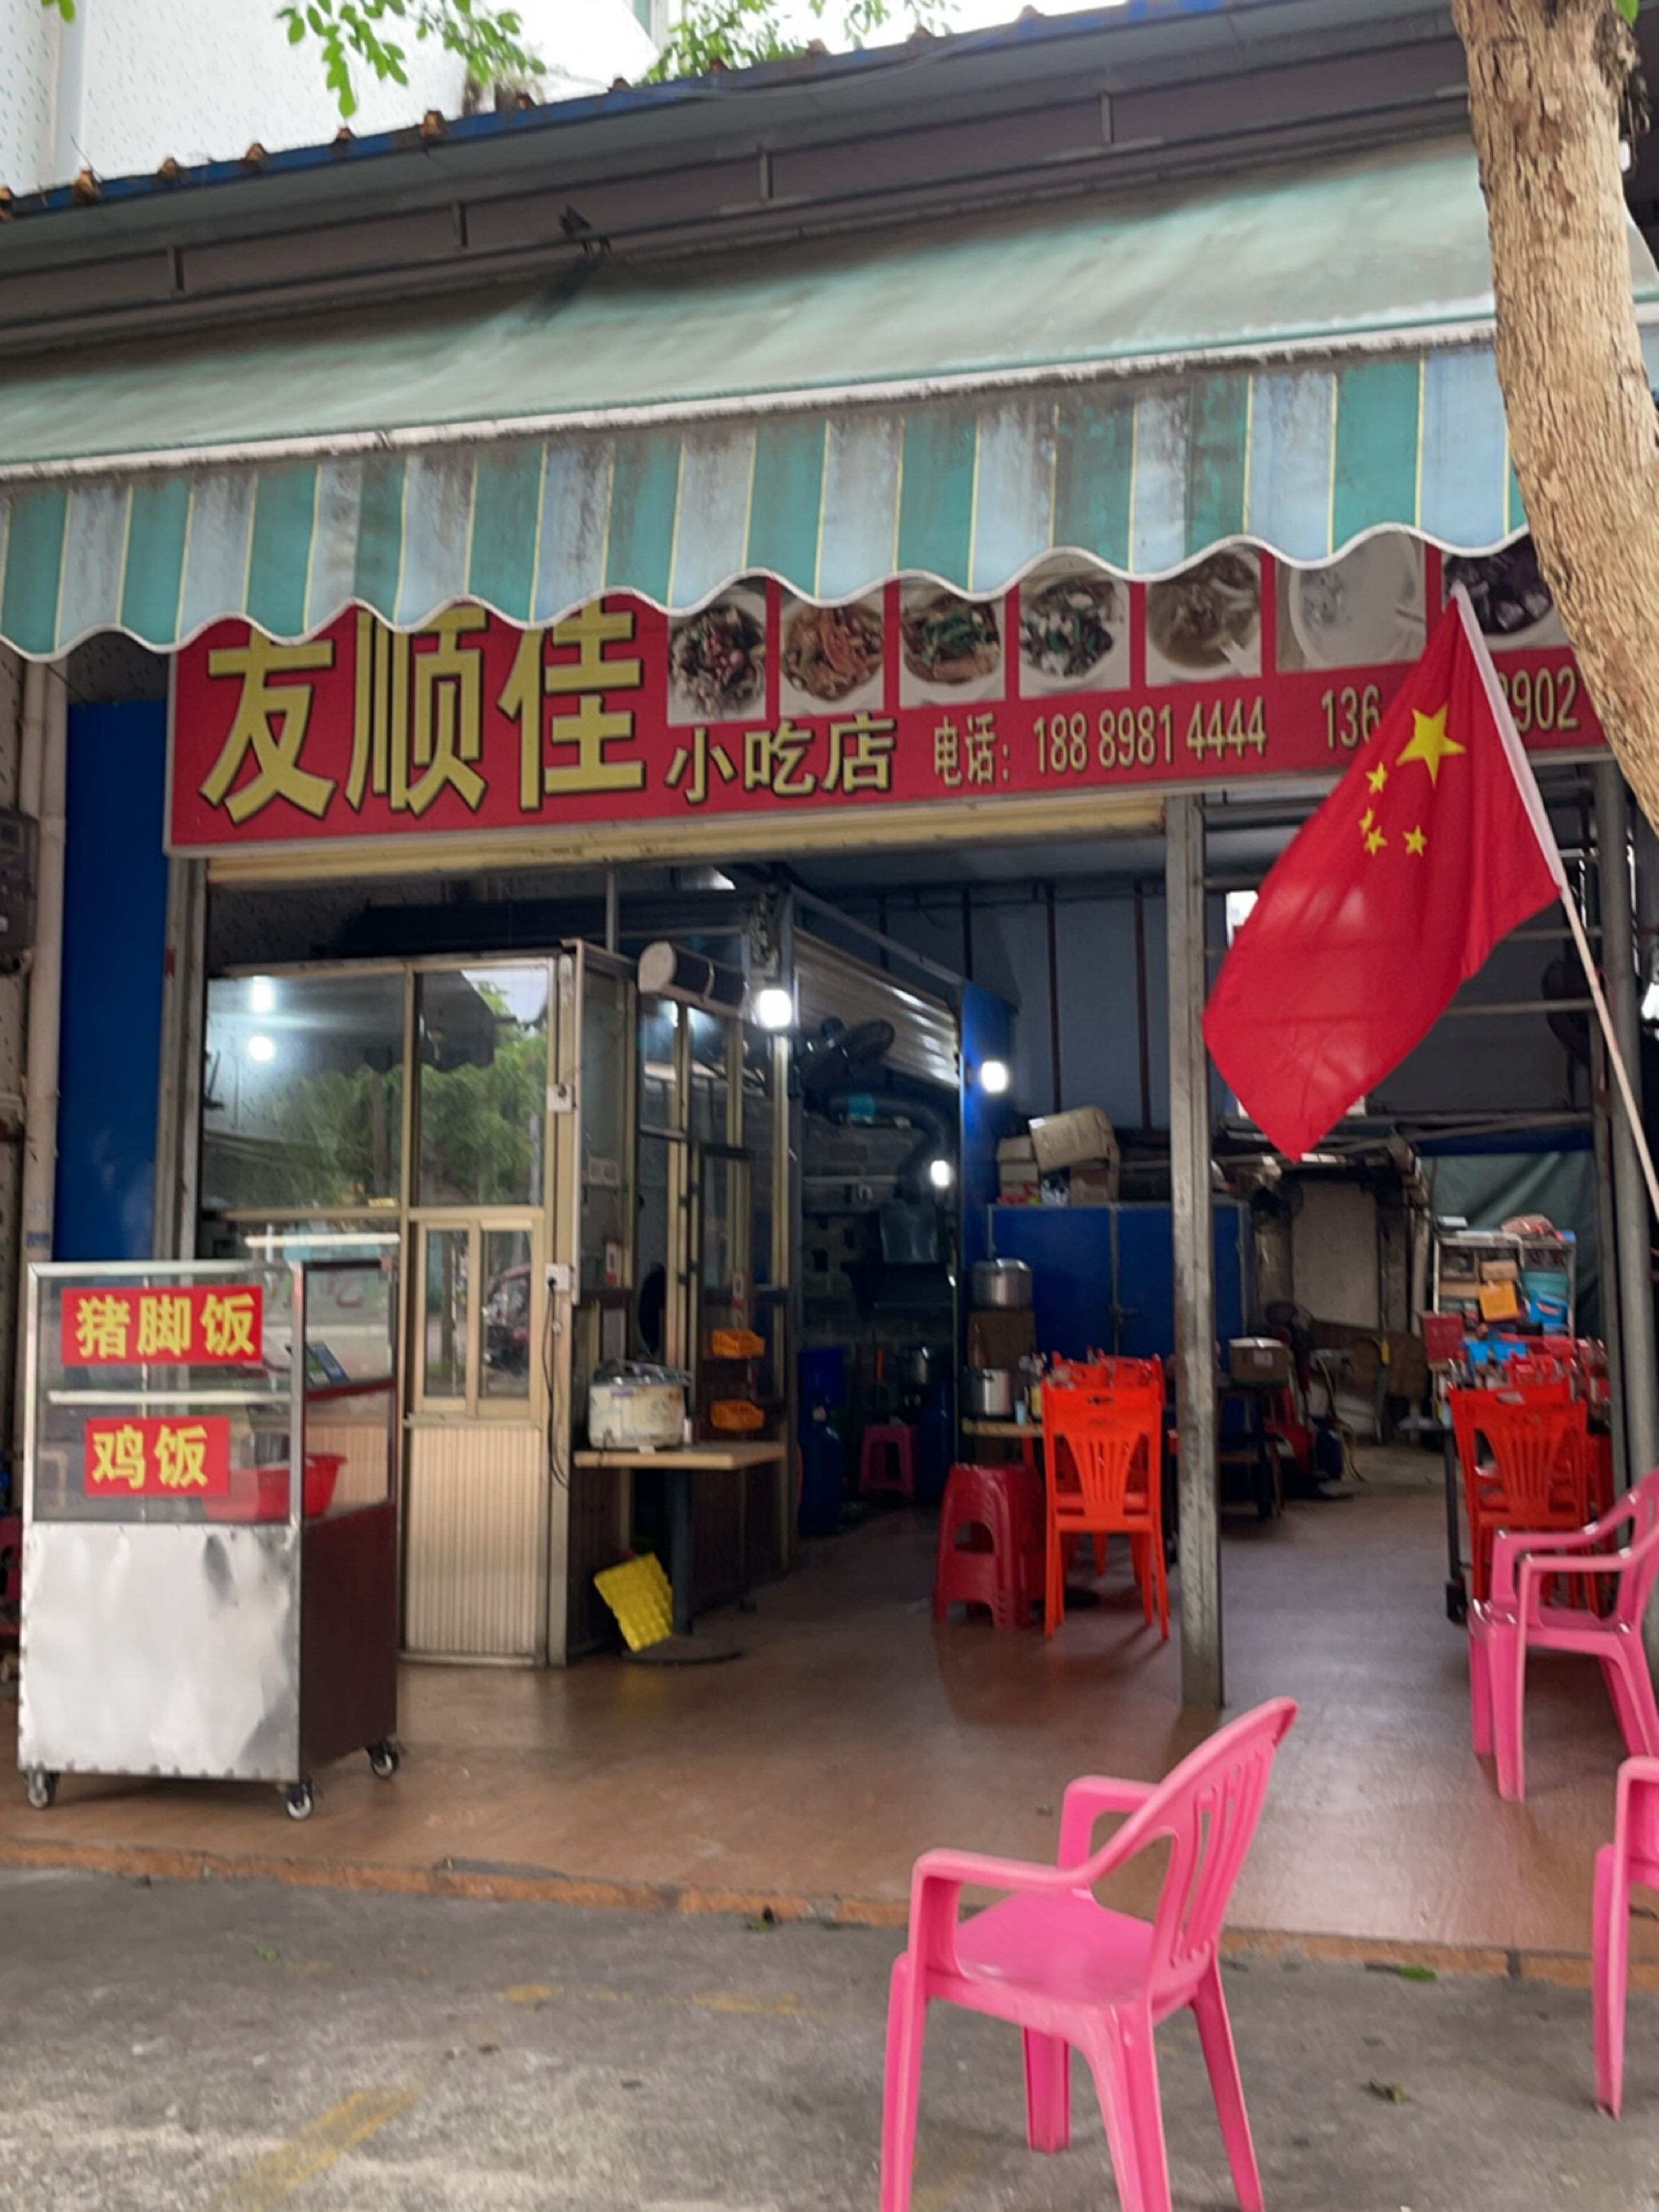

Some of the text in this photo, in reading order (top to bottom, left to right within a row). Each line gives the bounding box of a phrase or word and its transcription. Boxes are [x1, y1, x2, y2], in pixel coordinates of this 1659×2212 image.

[199, 597, 895, 825] 友顺佳 小吃店
[1032, 711, 1089, 774] 188
[1098, 704, 1174, 769] 8981
[1186, 694, 1268, 762] 4444
[1320, 684, 1381, 749] 136
[76, 1293, 256, 1359] 猪脚饭
[91, 1423, 209, 1489] 鸡饭
